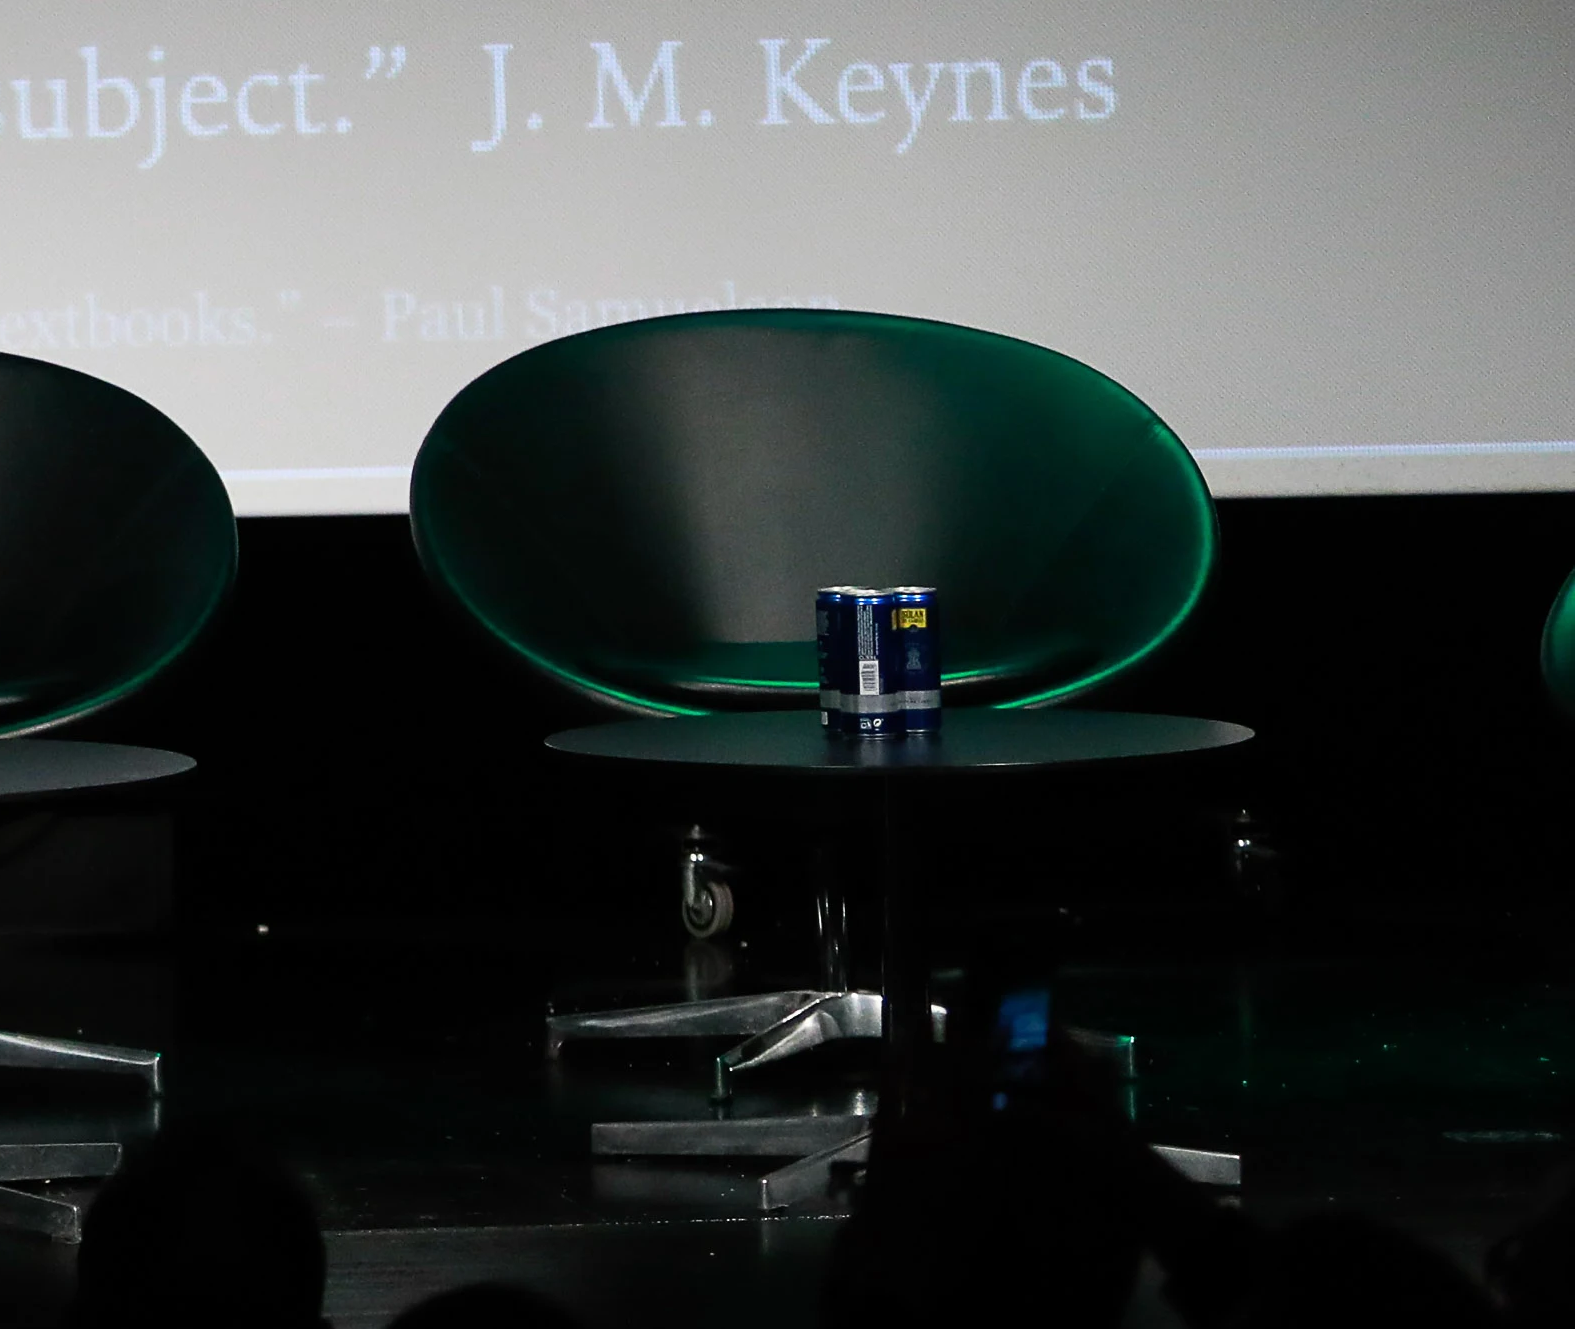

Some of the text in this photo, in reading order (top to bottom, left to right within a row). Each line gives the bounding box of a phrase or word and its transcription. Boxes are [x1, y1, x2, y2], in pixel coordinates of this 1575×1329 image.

[471, 43, 544, 152] J.
[585, 40, 713, 130] M.
[757, 37, 1118, 155] Keynes
[380, 285, 505, 343] Paul
